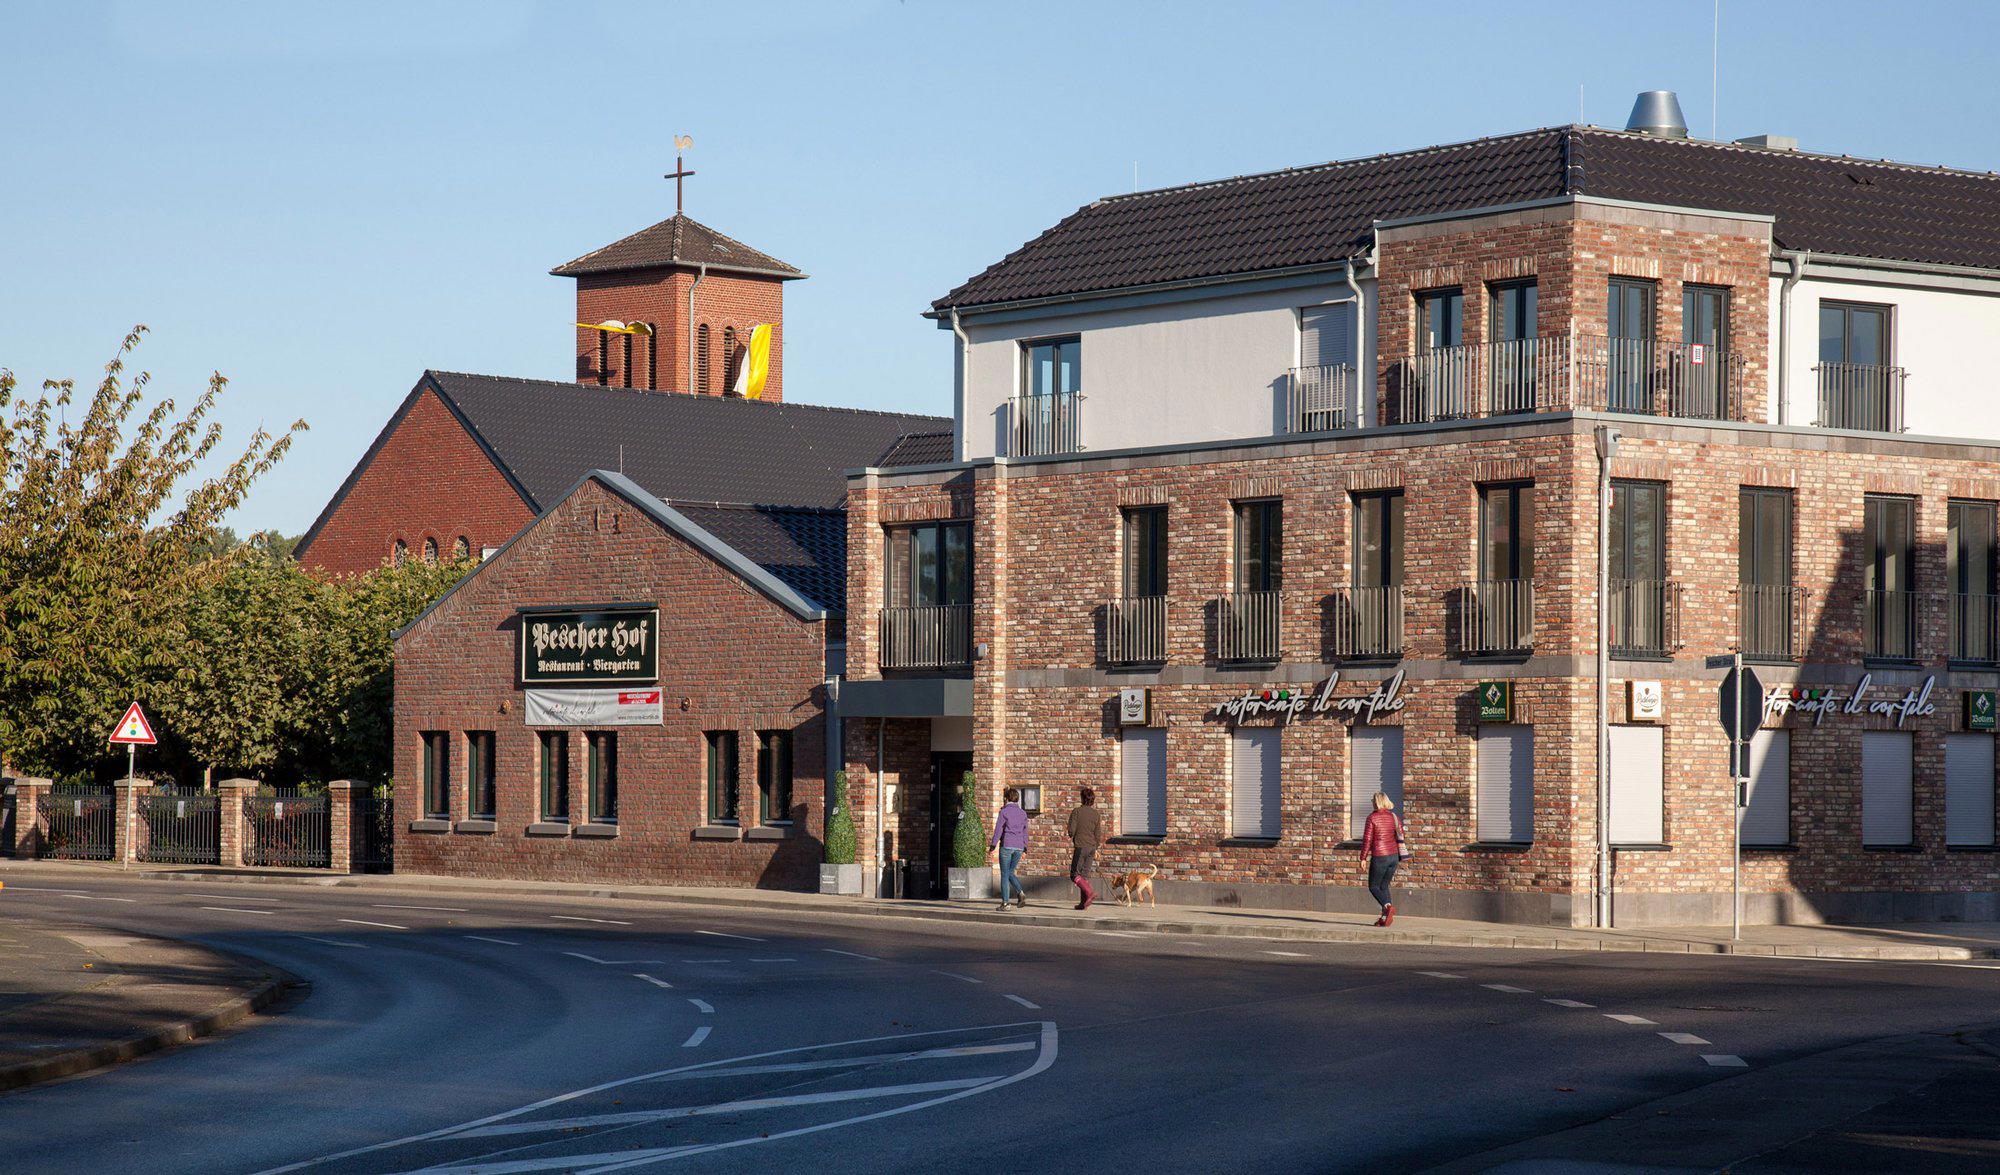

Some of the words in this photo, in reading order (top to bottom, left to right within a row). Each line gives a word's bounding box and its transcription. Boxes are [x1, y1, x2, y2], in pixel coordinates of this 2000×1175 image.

[532, 622, 608, 658] Pescher
[611, 620, 648, 657] Hof
[537, 659, 584, 673] Restaurant
[593, 658, 640, 674] Biergarten
[1215, 688, 1307, 725] ristorante
[1312, 670, 1339, 712] il
[1339, 669, 1405, 724] cortile
[1844, 673, 1871, 714] il
[1870, 674, 1936, 728] cortile
